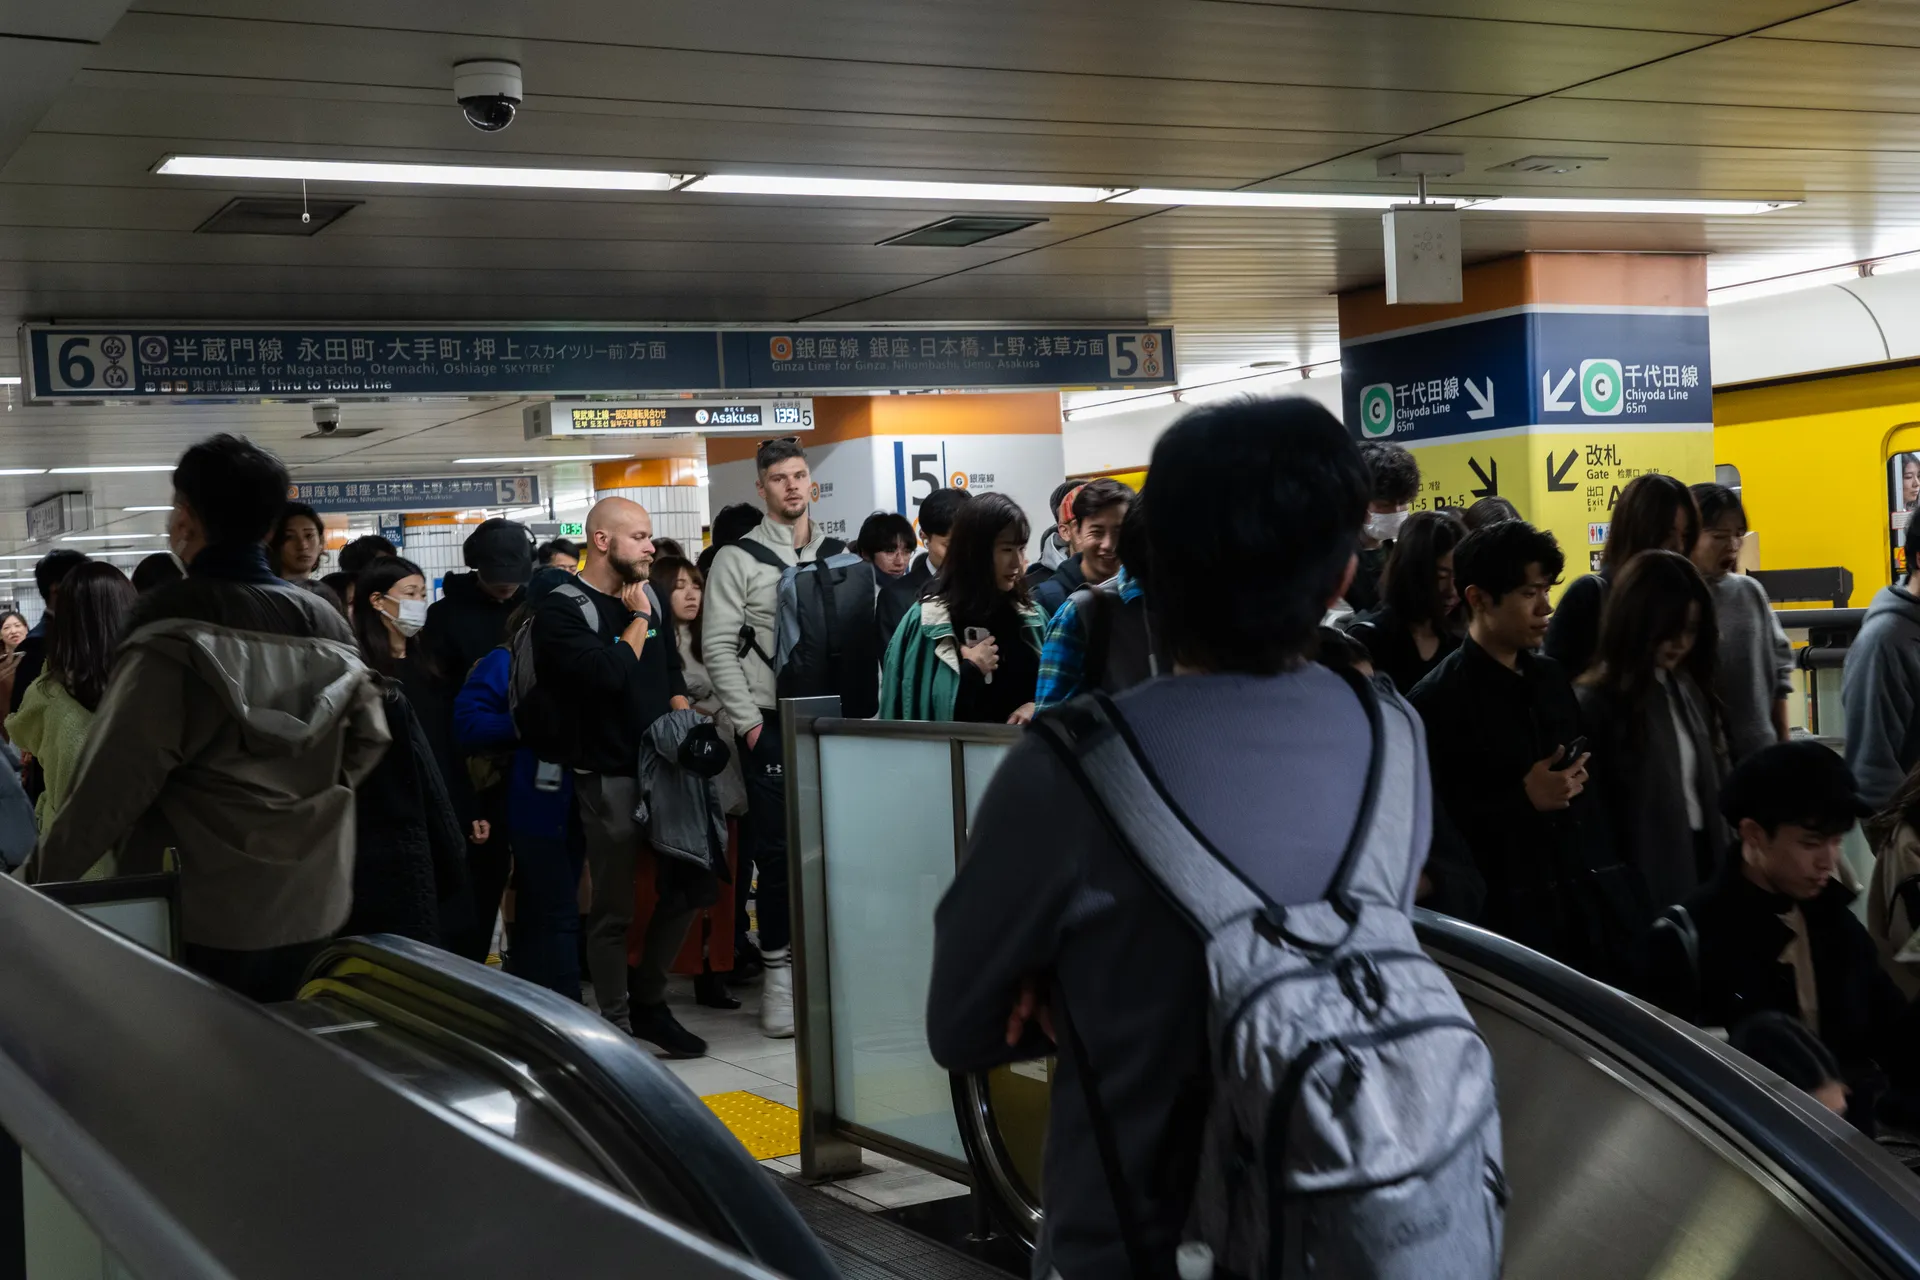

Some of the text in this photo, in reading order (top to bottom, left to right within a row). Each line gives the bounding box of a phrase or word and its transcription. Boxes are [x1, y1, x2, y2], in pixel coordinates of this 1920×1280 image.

[106, 345, 122, 354] 02
[173, 337, 284, 362] 半蔵門線
[796, 337, 860, 359] 銀座線
[59, 337, 95, 389] 6
[1115, 336, 1138, 376] 5
[142, 363, 221, 376] Hanzomon
[227, 363, 256, 376] Line
[261, 363, 281, 376] for
[287, 362, 365, 378] Nagatacho,
[371, 362, 439, 376] Otemachi,
[444, 362, 497, 376] Oshiage
[771, 360, 804, 372] Ginza
[808, 360, 831, 371] Line
[835, 360, 852, 371] for
[855, 360, 889, 372] Ginza,
[893, 359, 959, 371] Nihombashi,
[997, 358, 1040, 369] Asakusa
[110, 374, 123, 383] 14
[1624, 364, 1699, 388] 千代田線
[192, 380, 260, 392] 東武線直通
[269, 378, 391, 390] Thru to Tobu Line
[1395, 376, 1460, 406] 千代田線
[1595, 379, 1606, 396] C
[1625, 388, 1689, 403] Chiyoda Line
[1372, 402, 1381, 419] C
[1396, 402, 1450, 421] Chiyoda Line
[1626, 402, 1647, 414] 65m
[711, 411, 759, 424] Asakusa
[803, 410, 812, 427] 5
[1397, 421, 1414, 432] 65m
[1585, 444, 1621, 466] 改札
[911, 454, 940, 506] 5
[969, 473, 995, 483] 銀座線
[1586, 469, 1609, 480] Gate
[300, 485, 340, 498] 銀座線
[501, 480, 516, 502] 5
[1587, 486, 1604, 497] 出口
[325, 496, 335, 504] for
[1587, 497, 1604, 507] Exit
[560, 523, 582, 535] 0:35
